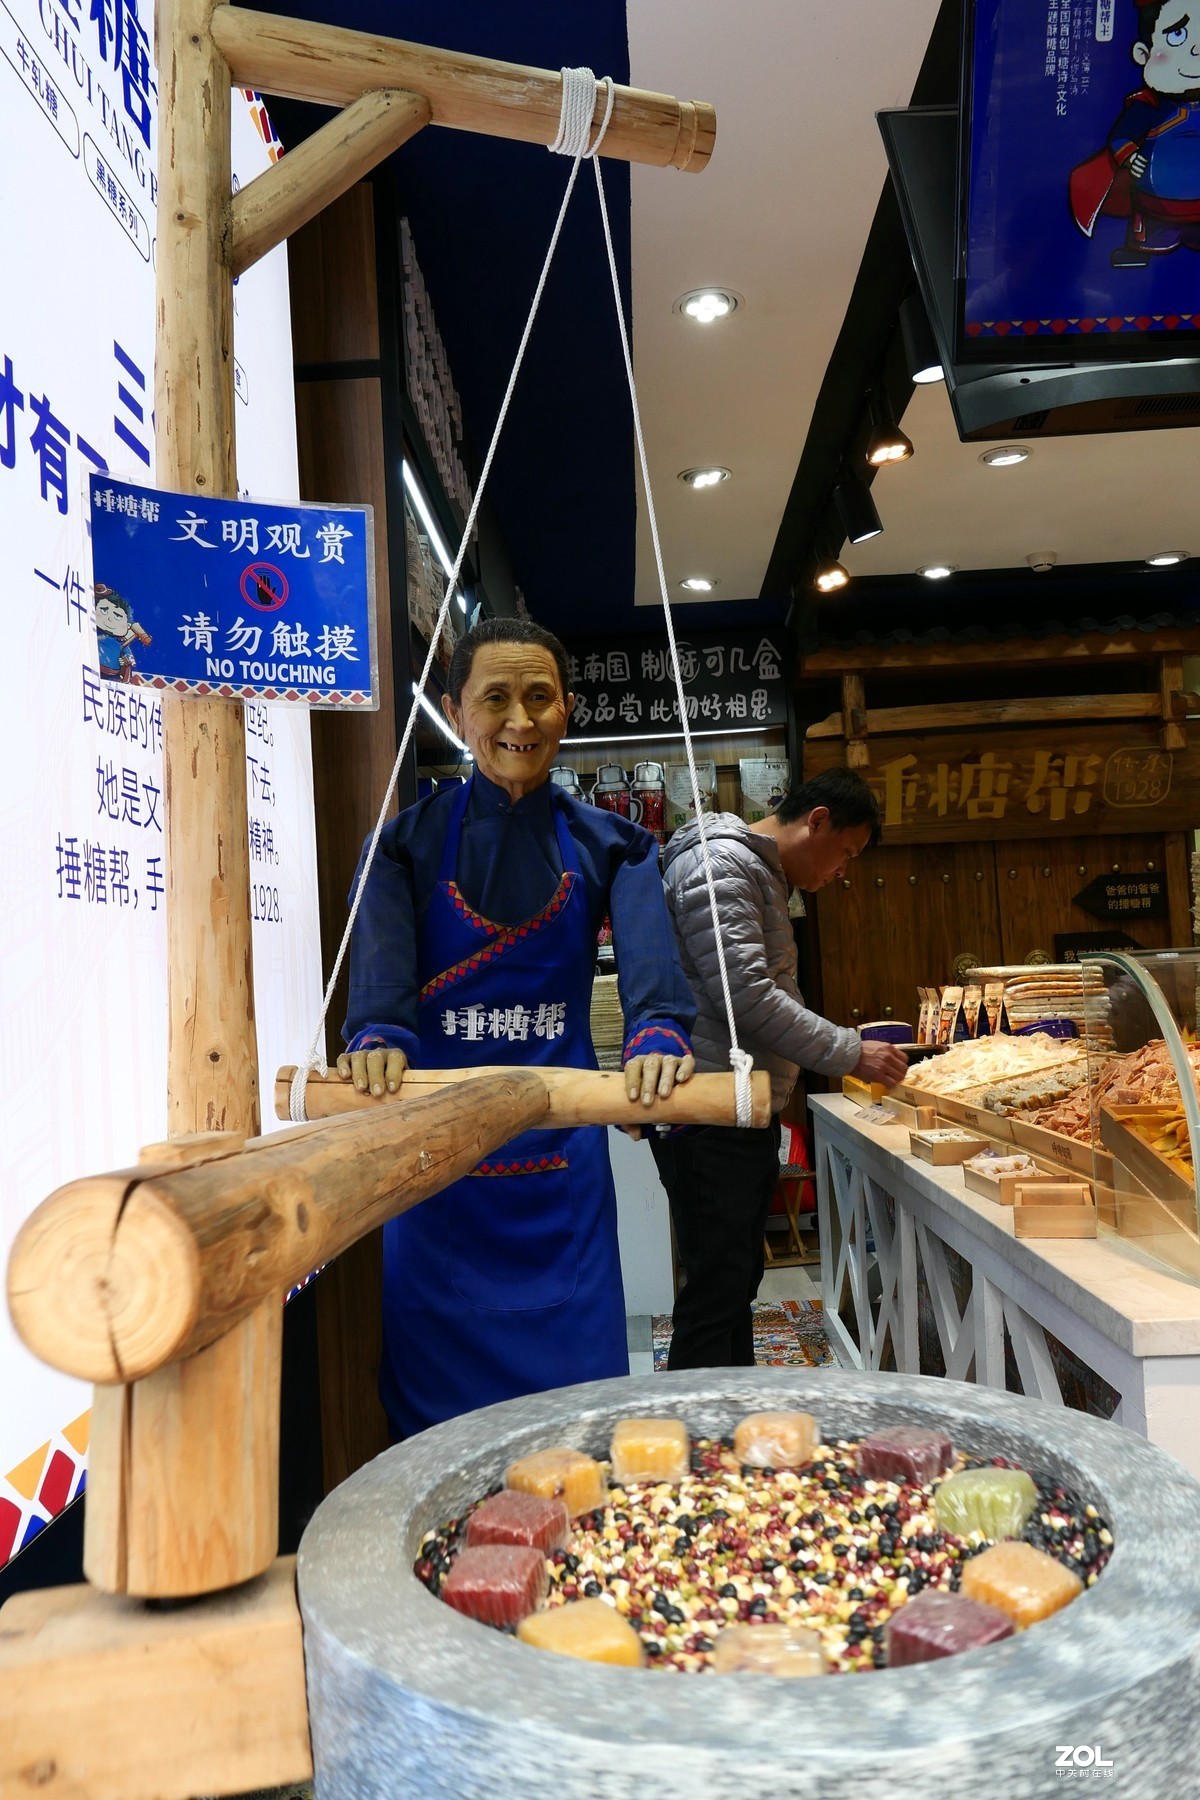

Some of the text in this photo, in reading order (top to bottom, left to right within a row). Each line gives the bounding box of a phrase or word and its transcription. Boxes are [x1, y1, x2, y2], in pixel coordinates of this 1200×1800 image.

[97, 83, 146, 188] TANG
[93, 488, 161, 523] 捶糖帮
[168, 510, 354, 565] 文明观赏
[176, 611, 361, 662] 请勿触摸
[206, 657, 336, 685] NO TOUCHING
[1113, 779, 1163, 801] 1928
[441, 1002, 567, 1041] 捶糖帮
